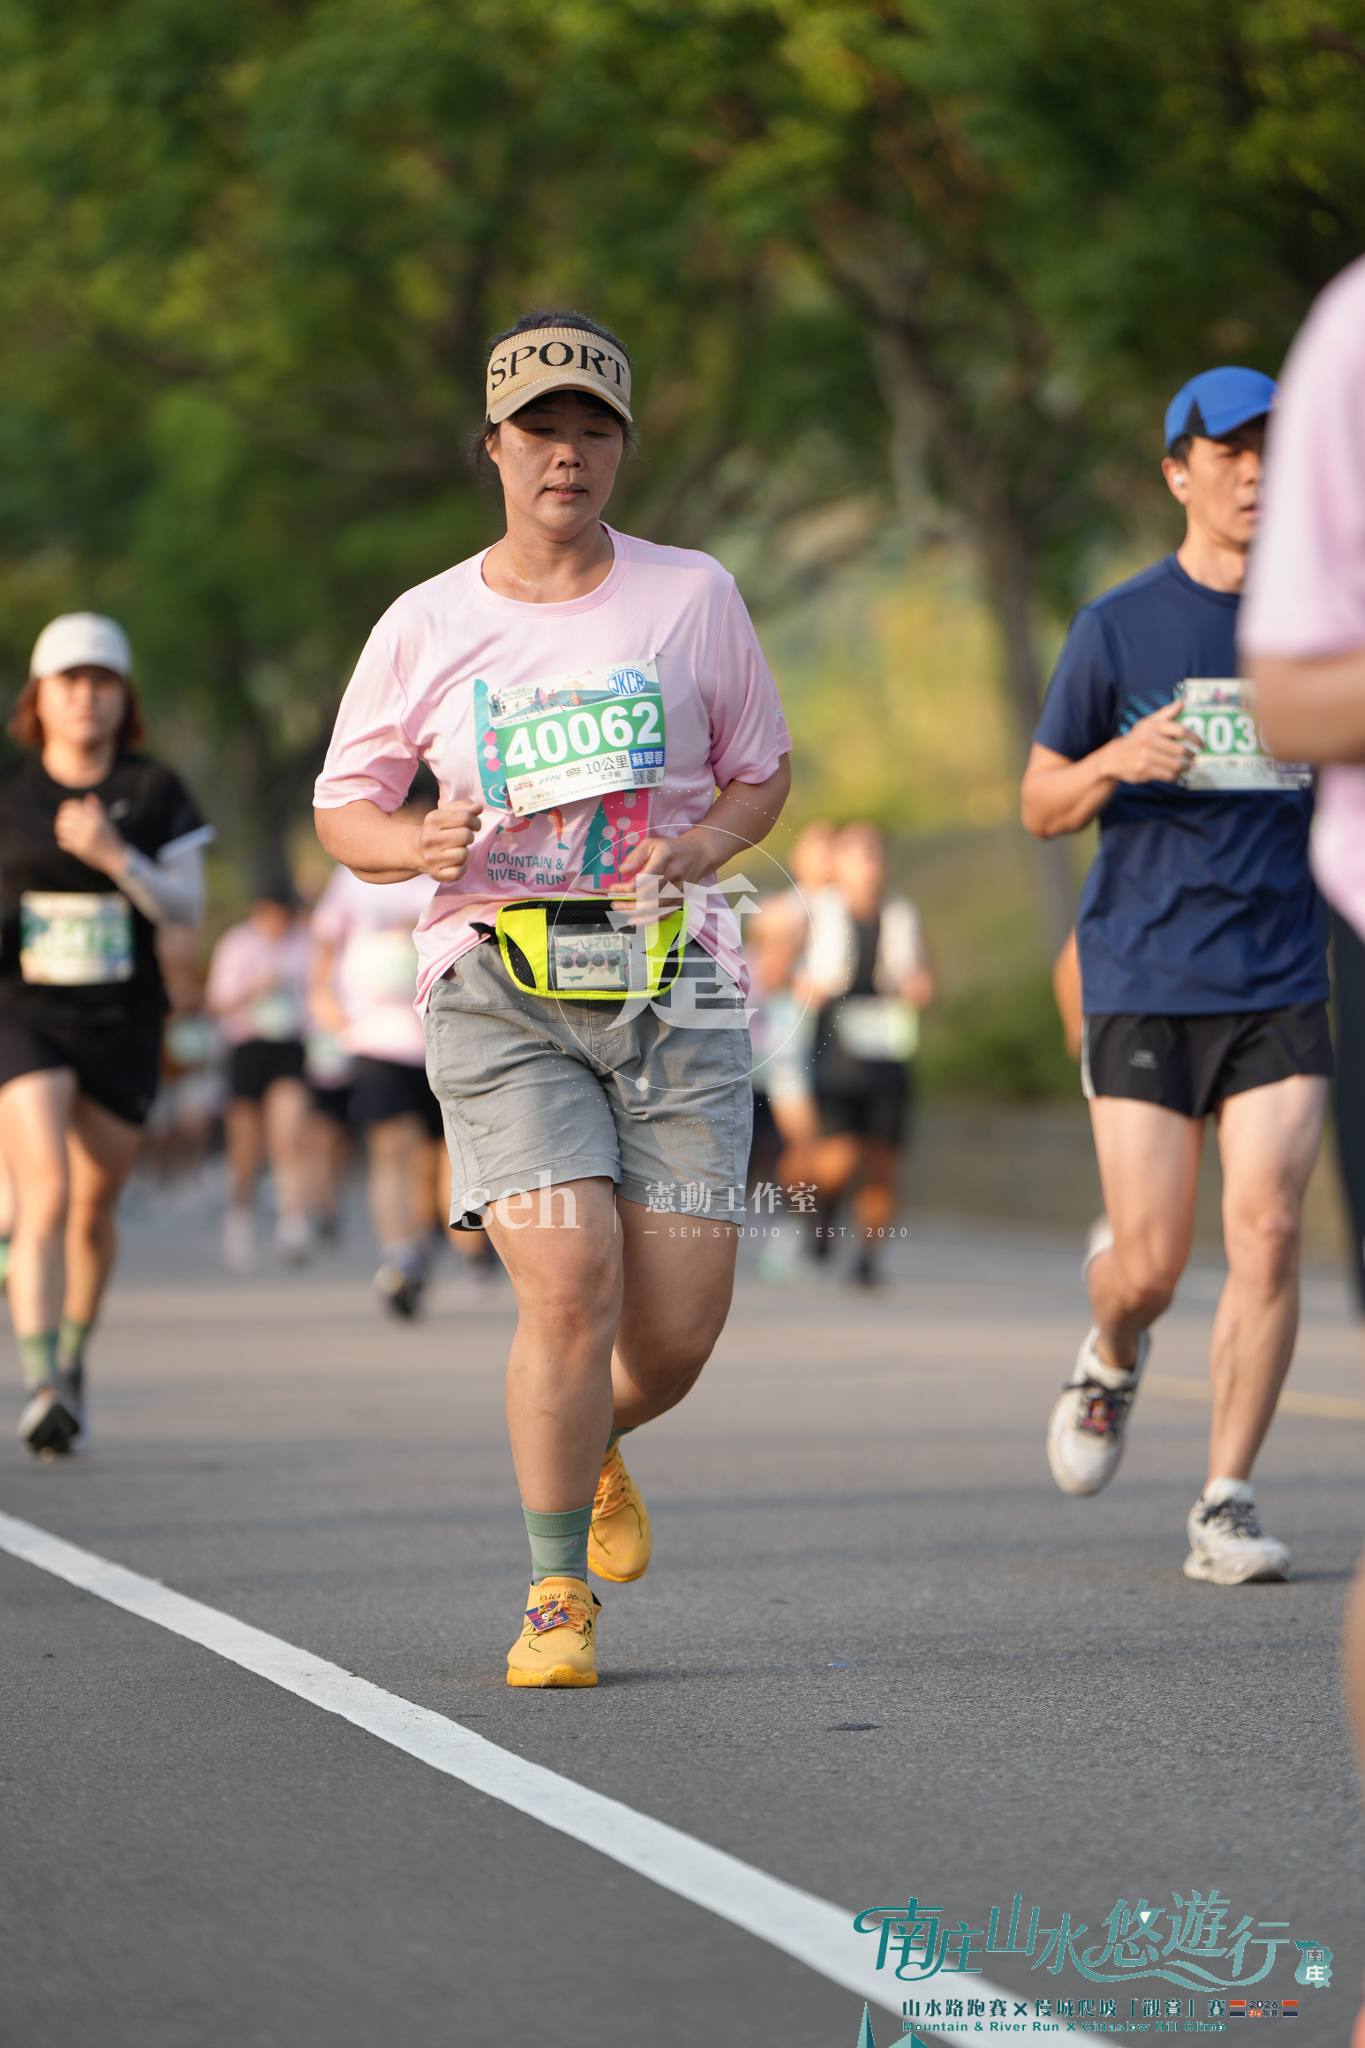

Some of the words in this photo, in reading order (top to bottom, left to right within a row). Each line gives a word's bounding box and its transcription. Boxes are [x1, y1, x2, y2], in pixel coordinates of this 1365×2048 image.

[490, 341, 625, 391] SPORT
[505, 702, 661, 769] 40062
[586, 754, 630, 775] 10公里
[487, 851, 552, 869] MOUNTAIN
[555, 858, 565, 871] &
[487, 868, 526, 883] RIVER
[536, 872, 566, 886] RUN
